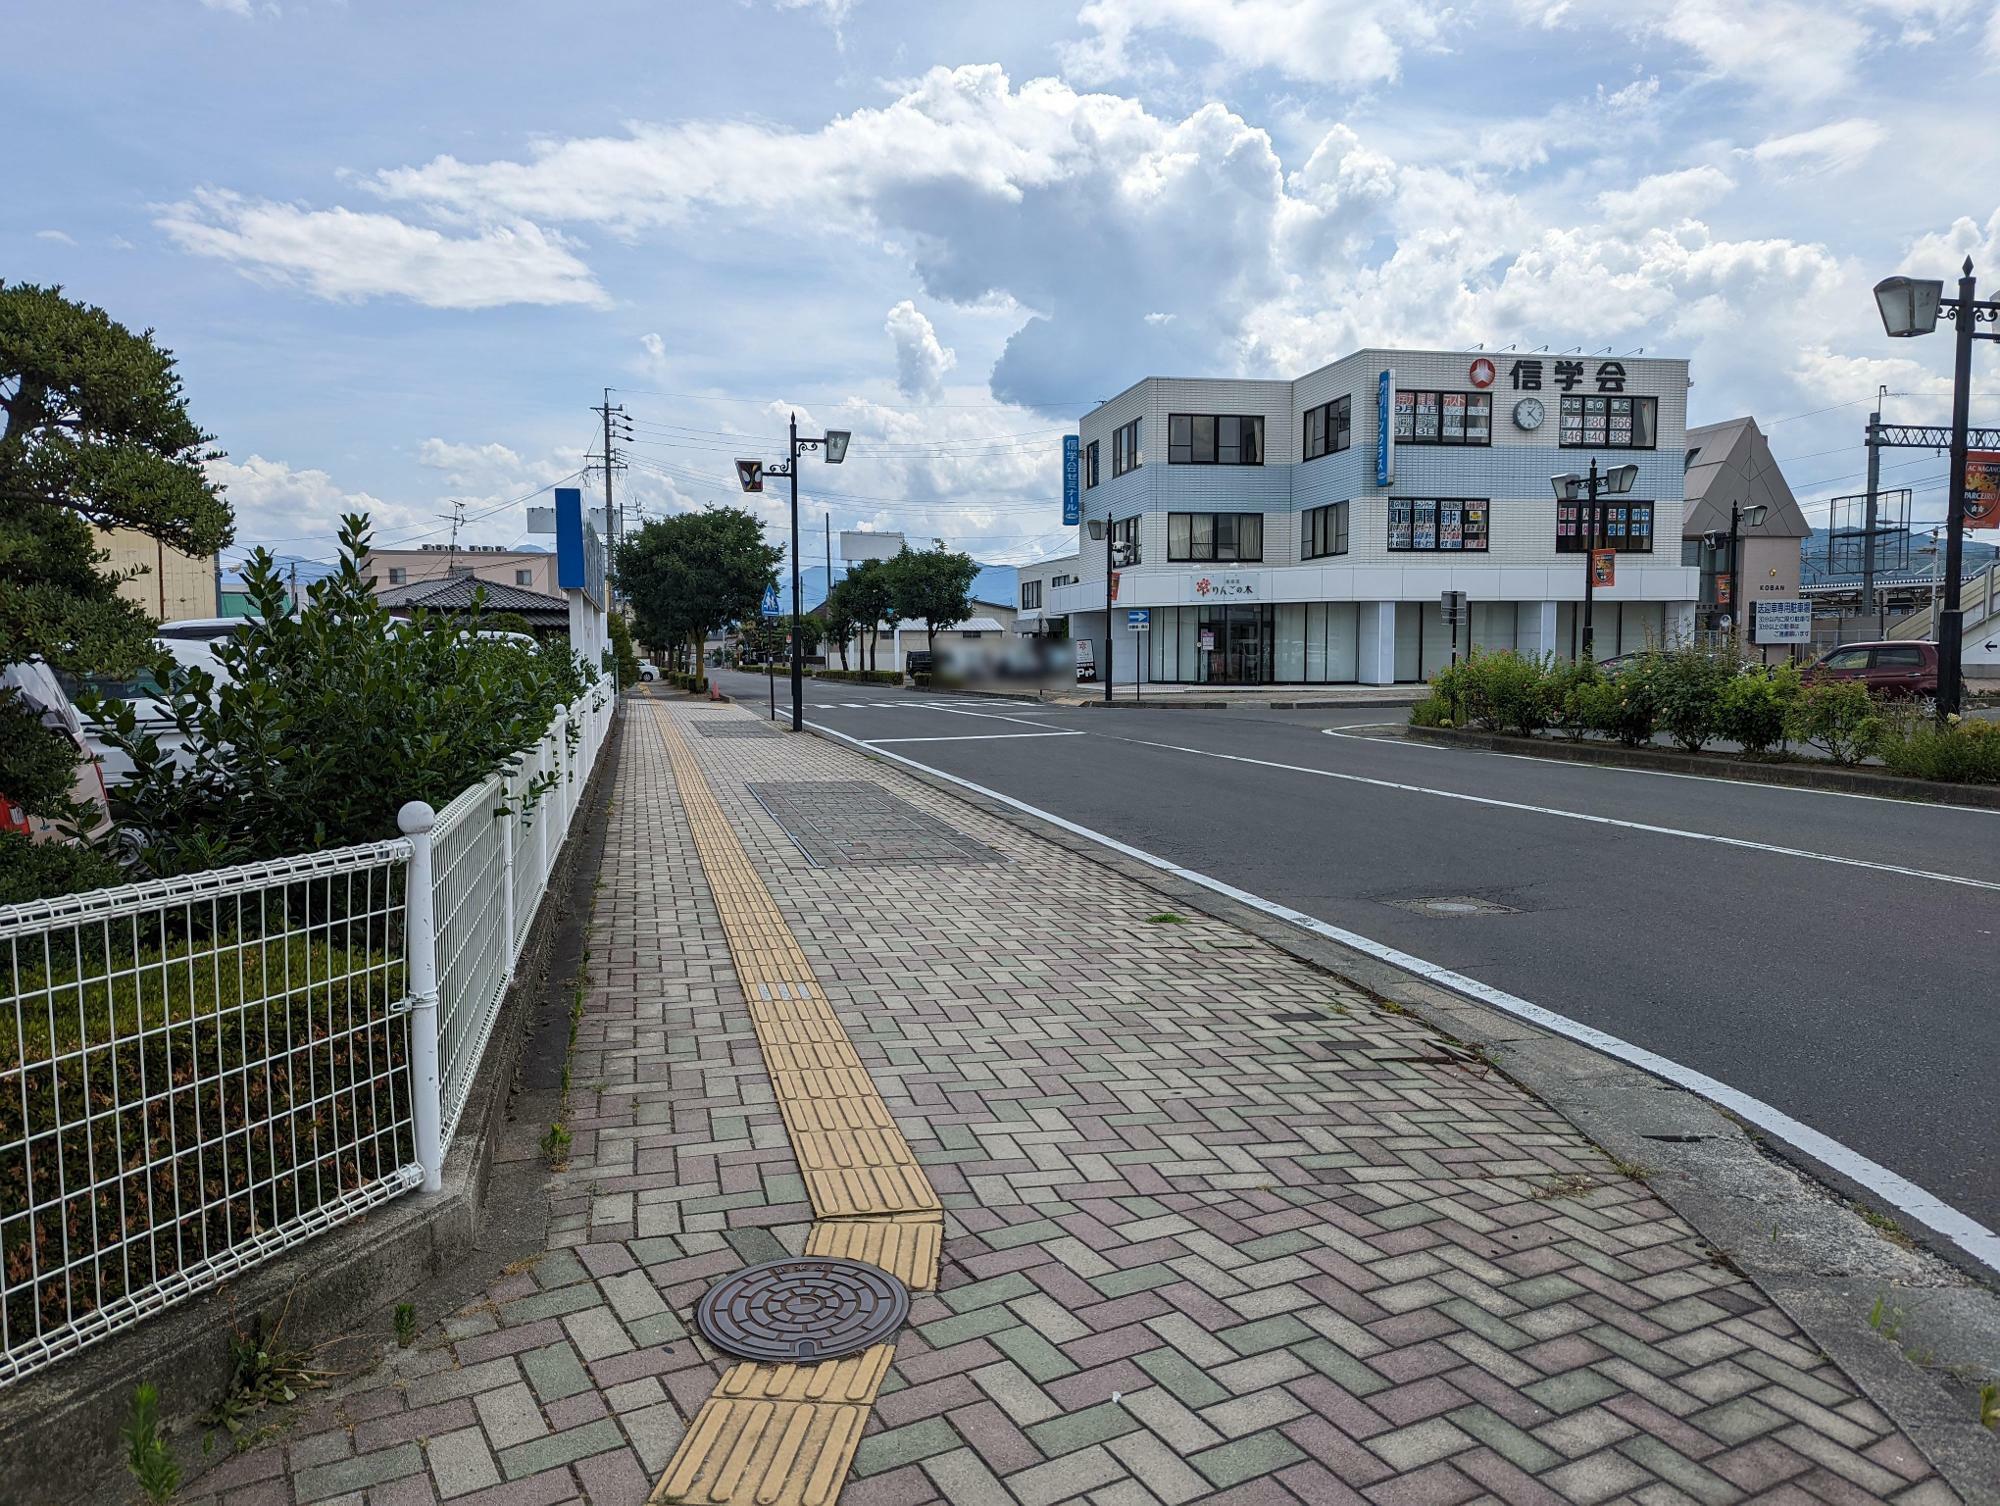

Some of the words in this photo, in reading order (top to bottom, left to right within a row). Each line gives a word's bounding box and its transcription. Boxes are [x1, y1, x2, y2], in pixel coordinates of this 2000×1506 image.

[1508, 360, 1626, 392] 信学会
[1066, 440, 1078, 511] 信学会ゼミナール
[1964, 491, 1996, 500] PARCEIRO
[1212, 585, 1253, 595] りんごの木
